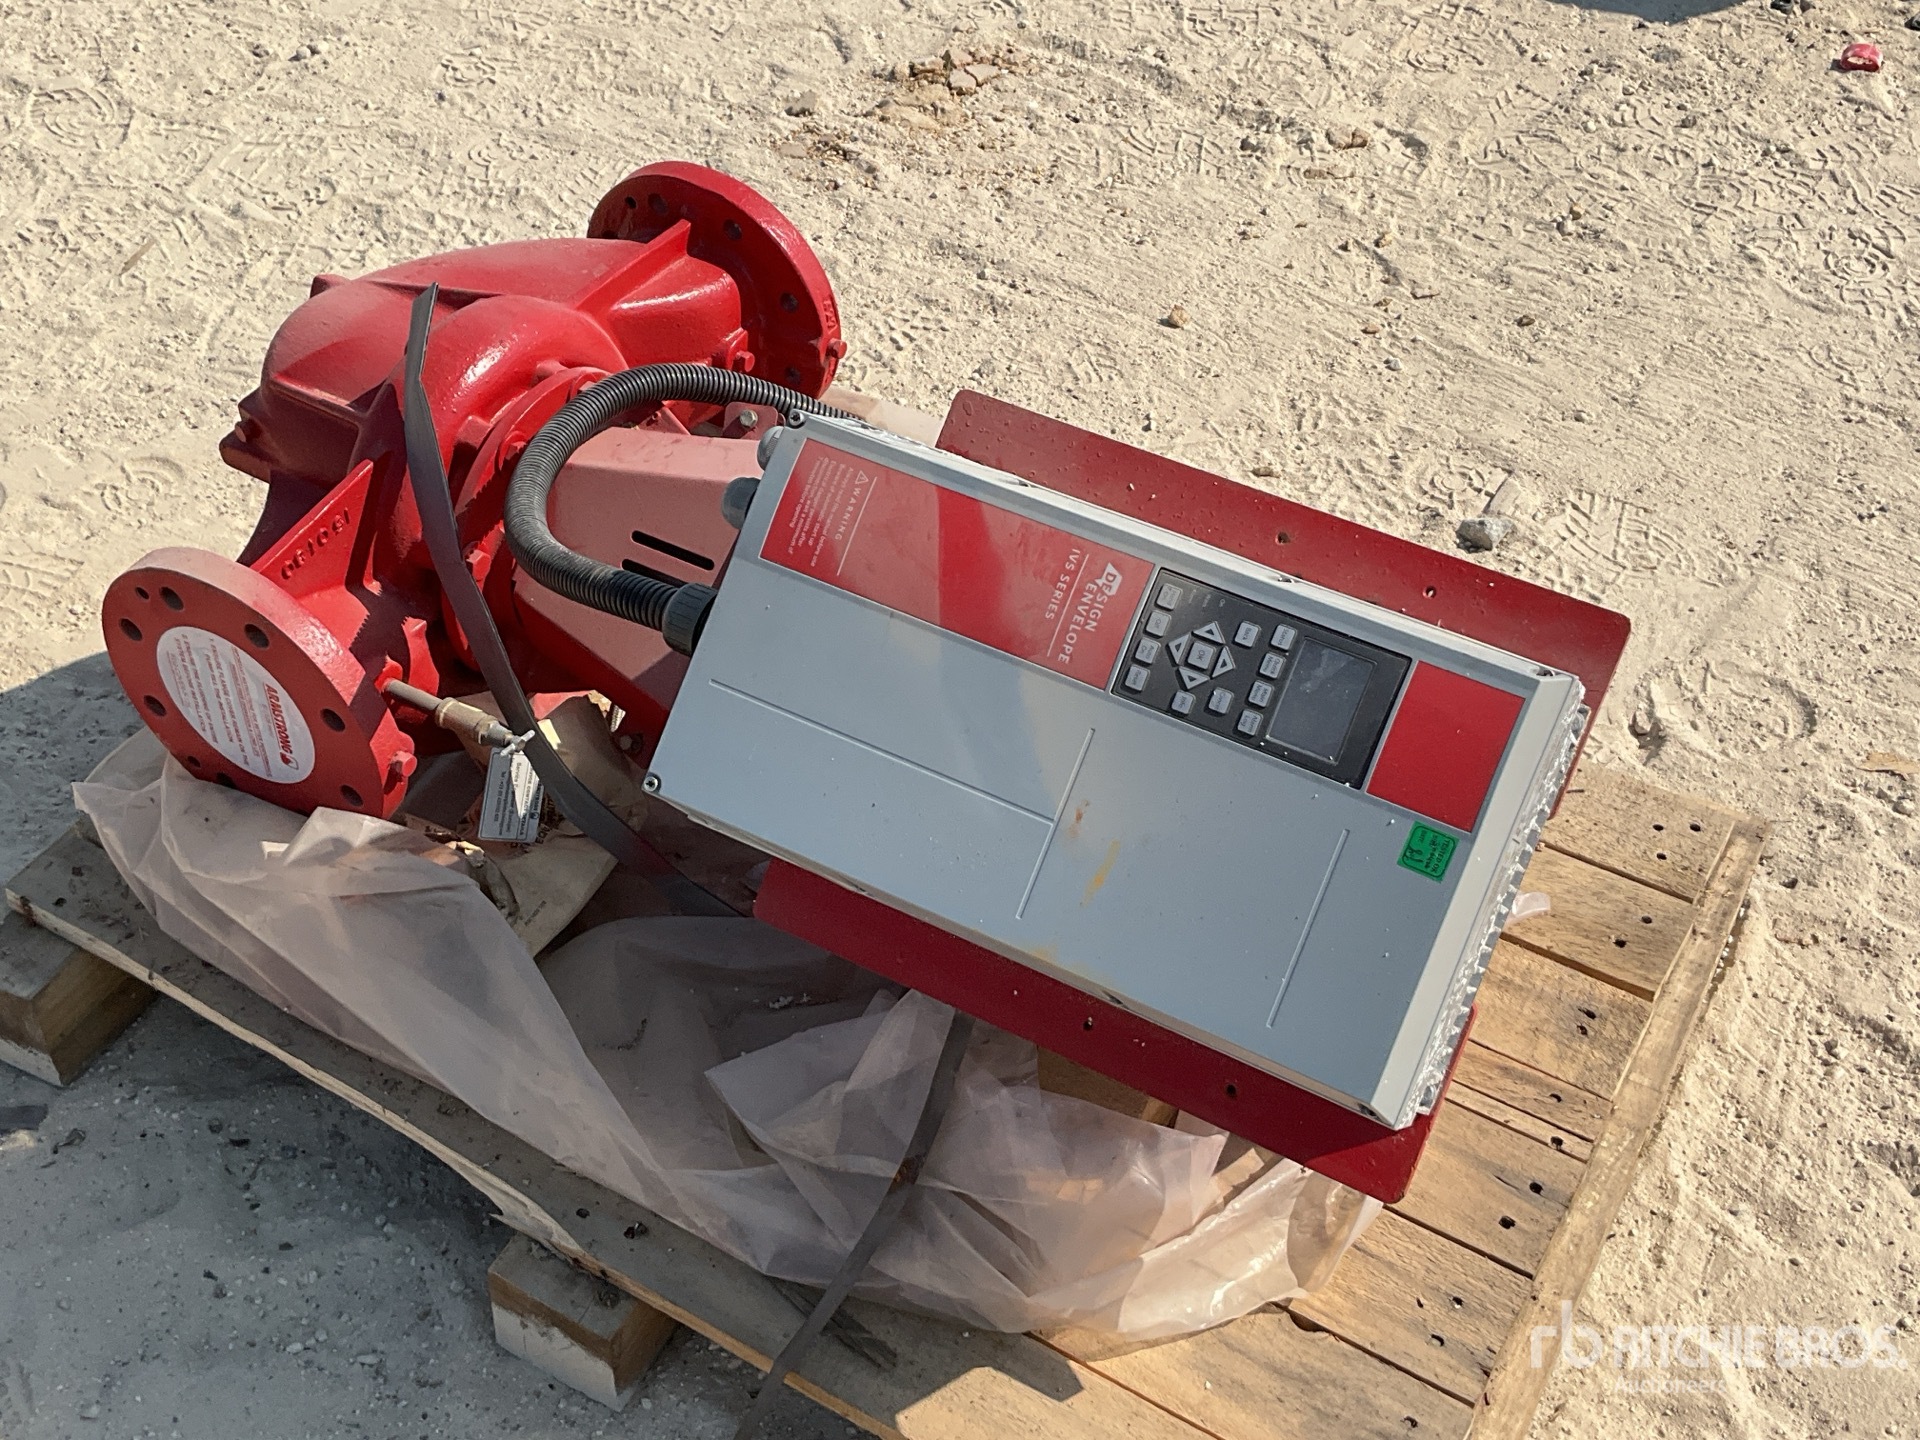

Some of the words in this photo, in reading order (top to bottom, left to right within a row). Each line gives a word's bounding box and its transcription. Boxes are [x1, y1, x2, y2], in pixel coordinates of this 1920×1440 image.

[788, 503, 802, 528] opening
[802, 499, 811, 512] wait
[833, 486, 861, 541] WARNING
[789, 517, 804, 546] minimum
[811, 522, 820, 537] start
[821, 513, 834, 535] manual
[787, 546, 794, 554] of
[797, 531, 806, 547] after
[807, 537, 814, 546] up
[814, 536, 826, 555] before
[1063, 547, 1080, 571] IVS
[1043, 573, 1070, 620] SERIES
[1083, 571, 1116, 632] DESIGN
[1056, 582, 1097, 664] ENVELOPE
[1194, 648, 1206, 661] OK
[217, 670, 230, 697] FLANGE
[225, 696, 236, 719] COVER
[265, 683, 292, 753] ARMSTRONG
